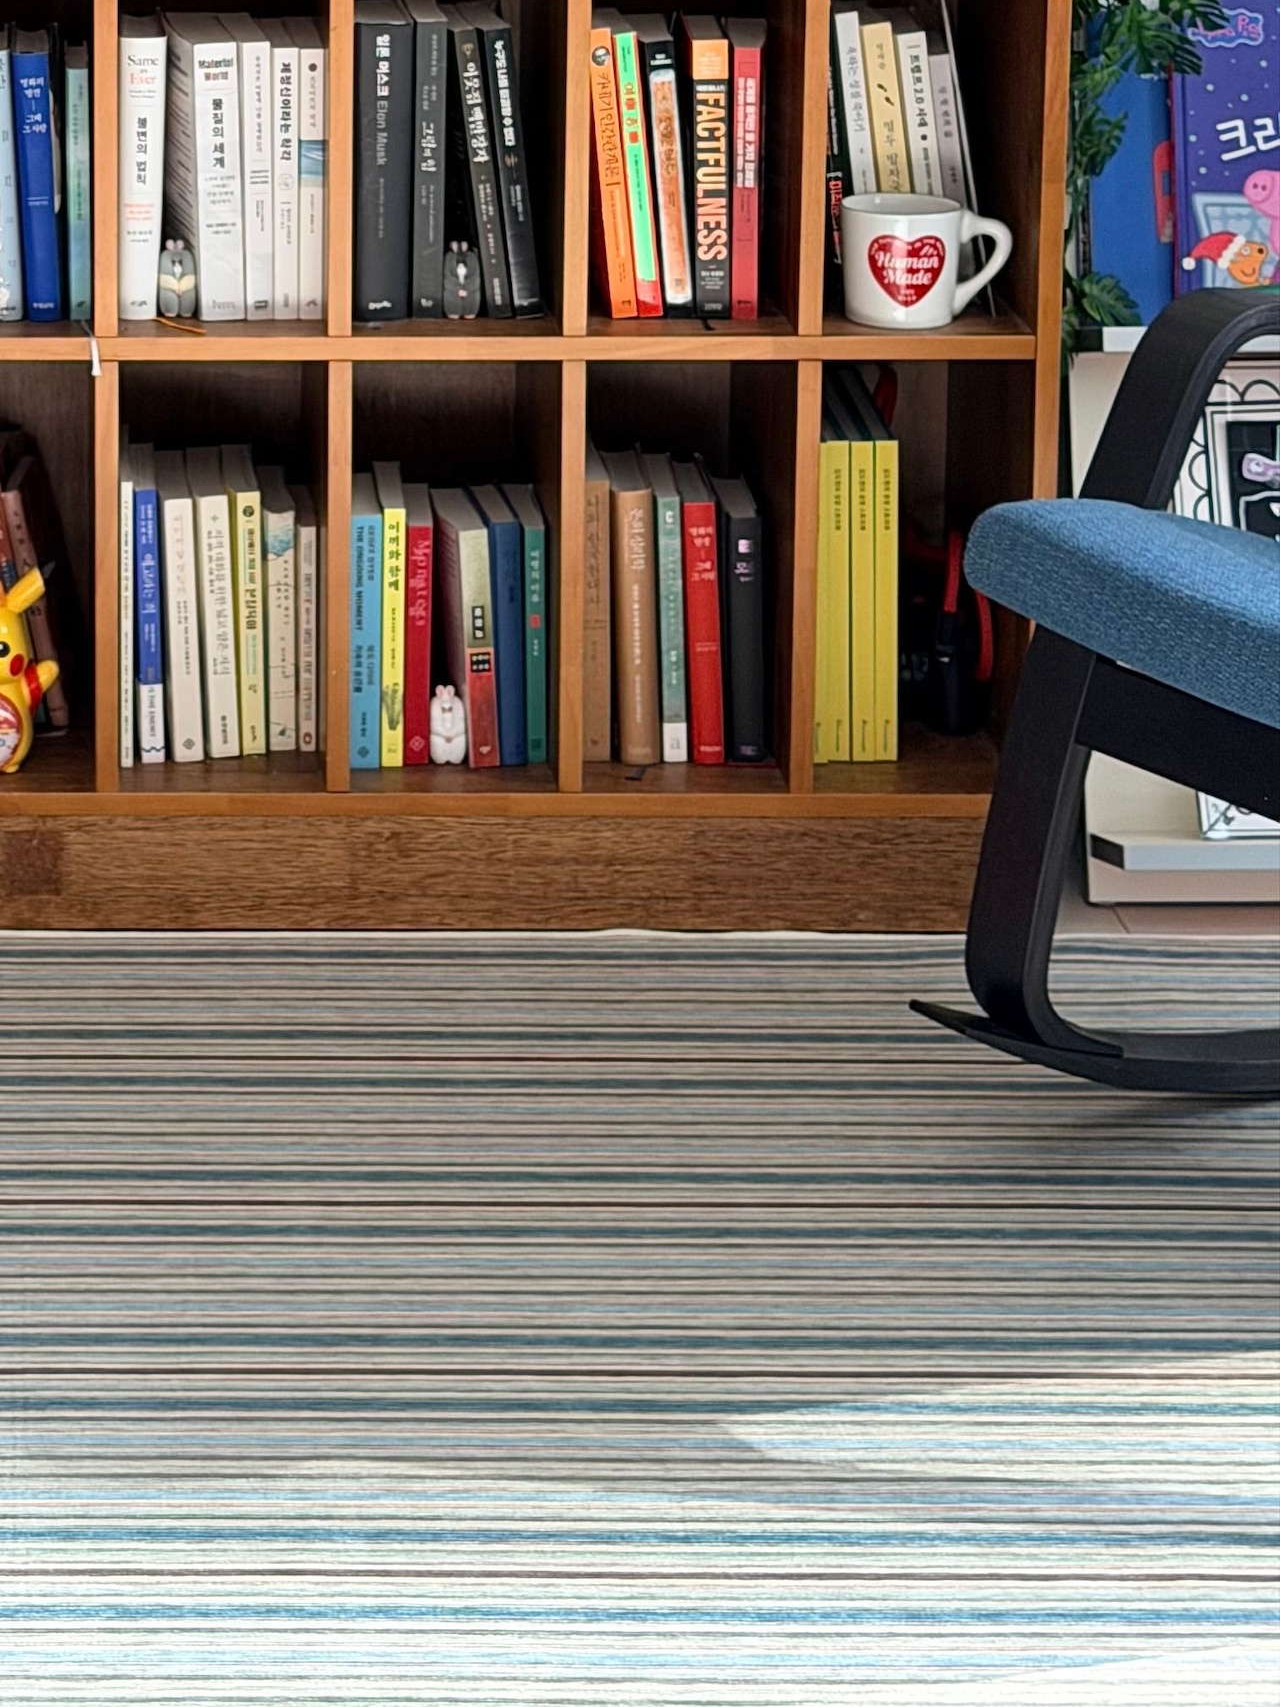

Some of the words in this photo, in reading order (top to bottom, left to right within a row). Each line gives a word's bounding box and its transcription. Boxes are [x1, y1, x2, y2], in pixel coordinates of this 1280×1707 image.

[127, 54, 160, 67] Same
[375, 34, 390, 58] 일론
[129, 72, 156, 86] Ever
[376, 60, 390, 97] 머스크
[462, 61, 482, 105] 이웃집
[909, 54, 923, 86] 트럼프
[279, 62, 292, 134] 제정신이라는
[913, 88, 925, 105] 2.0
[376, 100, 388, 129] Elon
[916, 107, 929, 128] 시대
[280, 137, 292, 161] 착각
[376, 132, 388, 165] Musk
[468, 106, 490, 164] 백만장자
[696, 92, 727, 261] FACTFULNESS
[875, 250, 939, 269] Human
[883, 269, 933, 285] Made
[355, 525, 364, 545] THE
[355, 546, 364, 588] ONGOING
[355, 590, 363, 632] MOMENT
